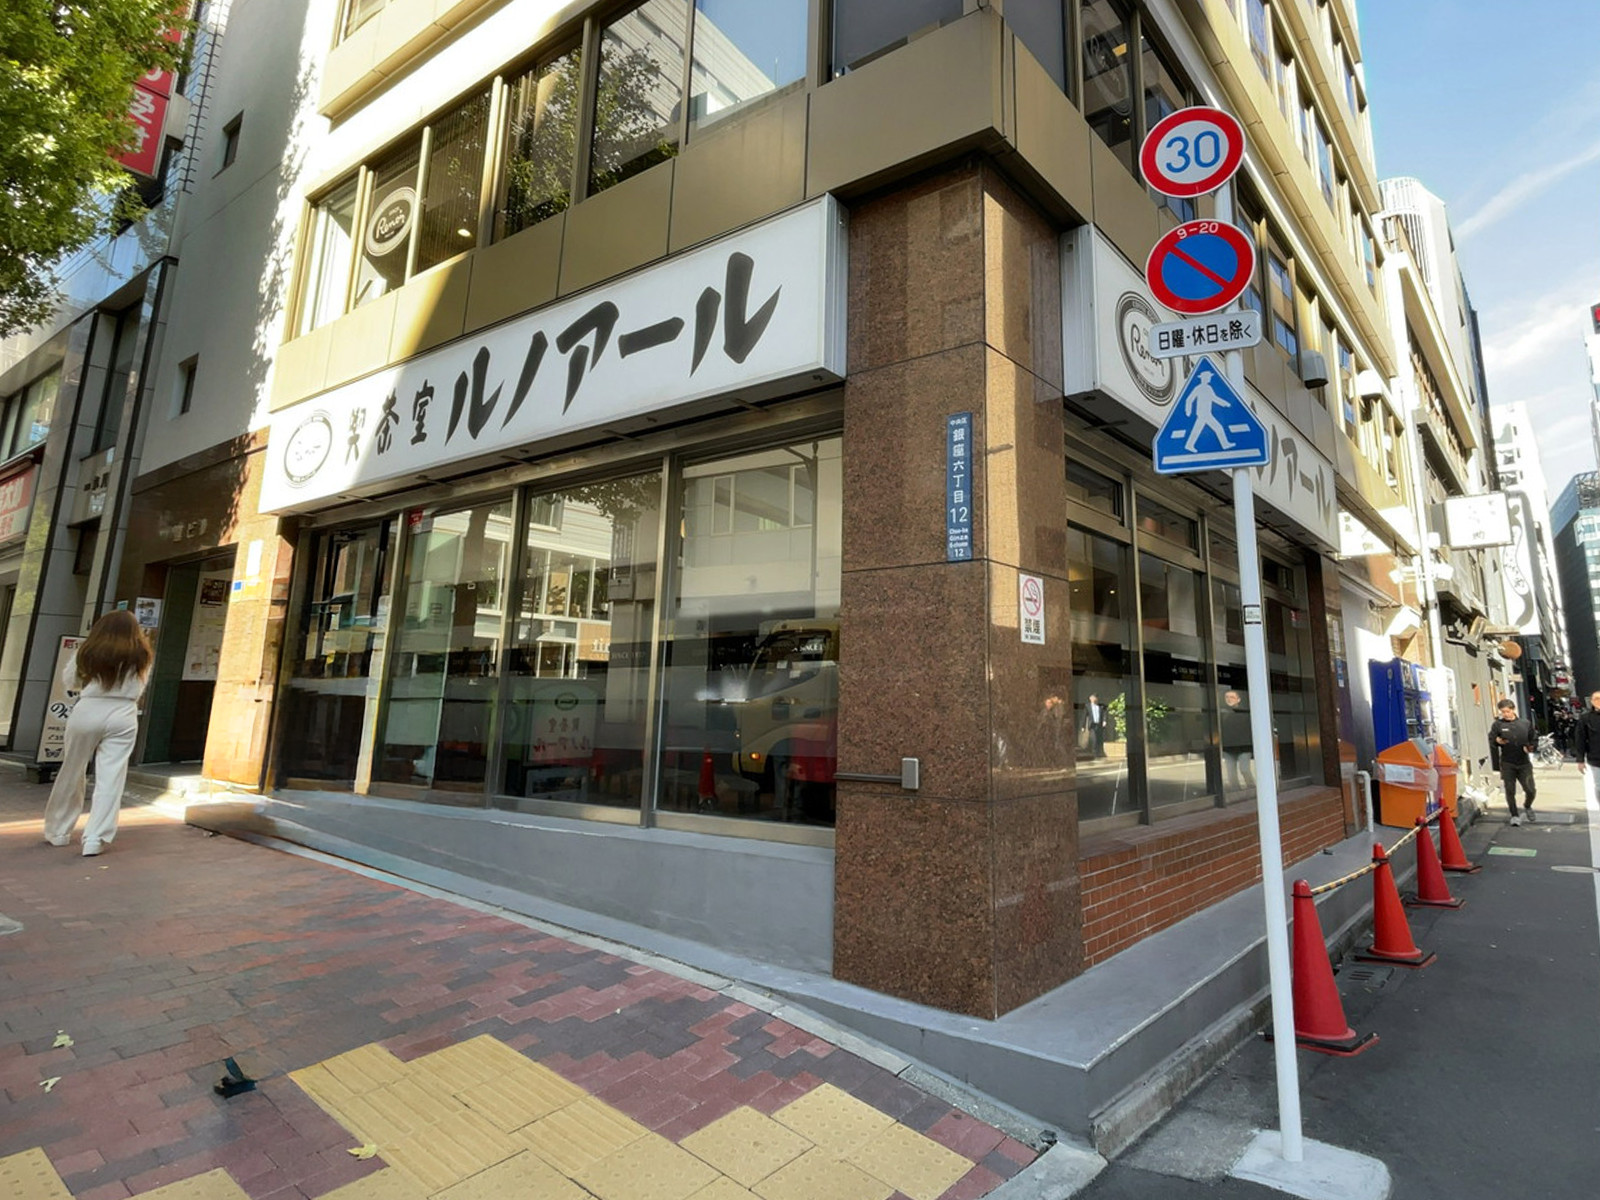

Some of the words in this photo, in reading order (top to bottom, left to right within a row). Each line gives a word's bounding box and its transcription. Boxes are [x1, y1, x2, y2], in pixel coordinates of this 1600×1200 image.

[1166, 130, 1220, 174] 30
[1176, 222, 1219, 240] 9-20
[1158, 319, 1252, 351] 日曜・休日を除く
[952, 427, 965, 504] 銀座六丁目
[949, 506, 968, 524] 12
[954, 548, 964, 558] 12
